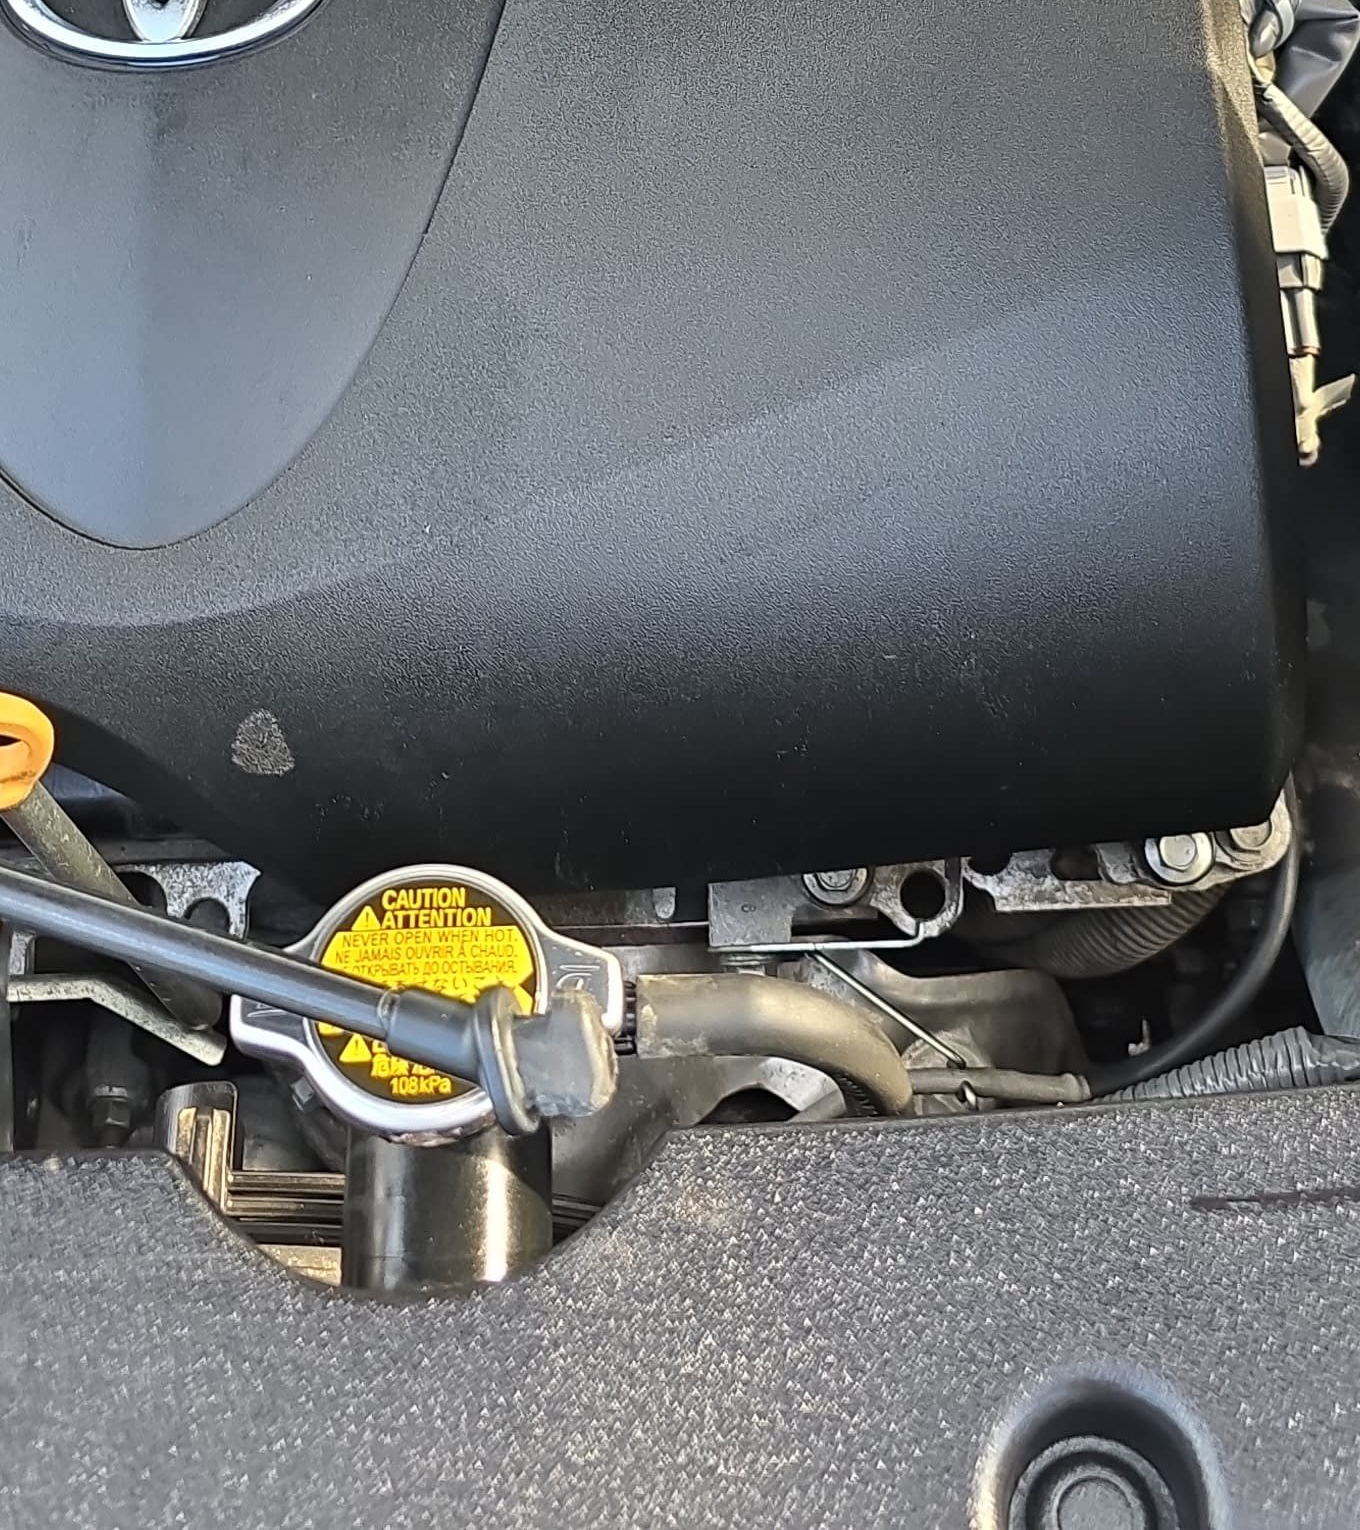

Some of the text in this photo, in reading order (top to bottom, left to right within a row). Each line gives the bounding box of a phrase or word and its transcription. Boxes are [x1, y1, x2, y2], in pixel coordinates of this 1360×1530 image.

[382, 887, 466, 910] CAUTION
[380, 907, 491, 929] ATTENTION
[342, 929, 518, 948] NEVER OPEN WHEN HOT.
[335, 950, 351, 964] NE
[355, 947, 402, 963] JAMAIS
[405, 945, 455, 960] OUVRIR
[470, 944, 518, 959] CHAUD.
[390, 1076, 452, 1095] 108kPa
